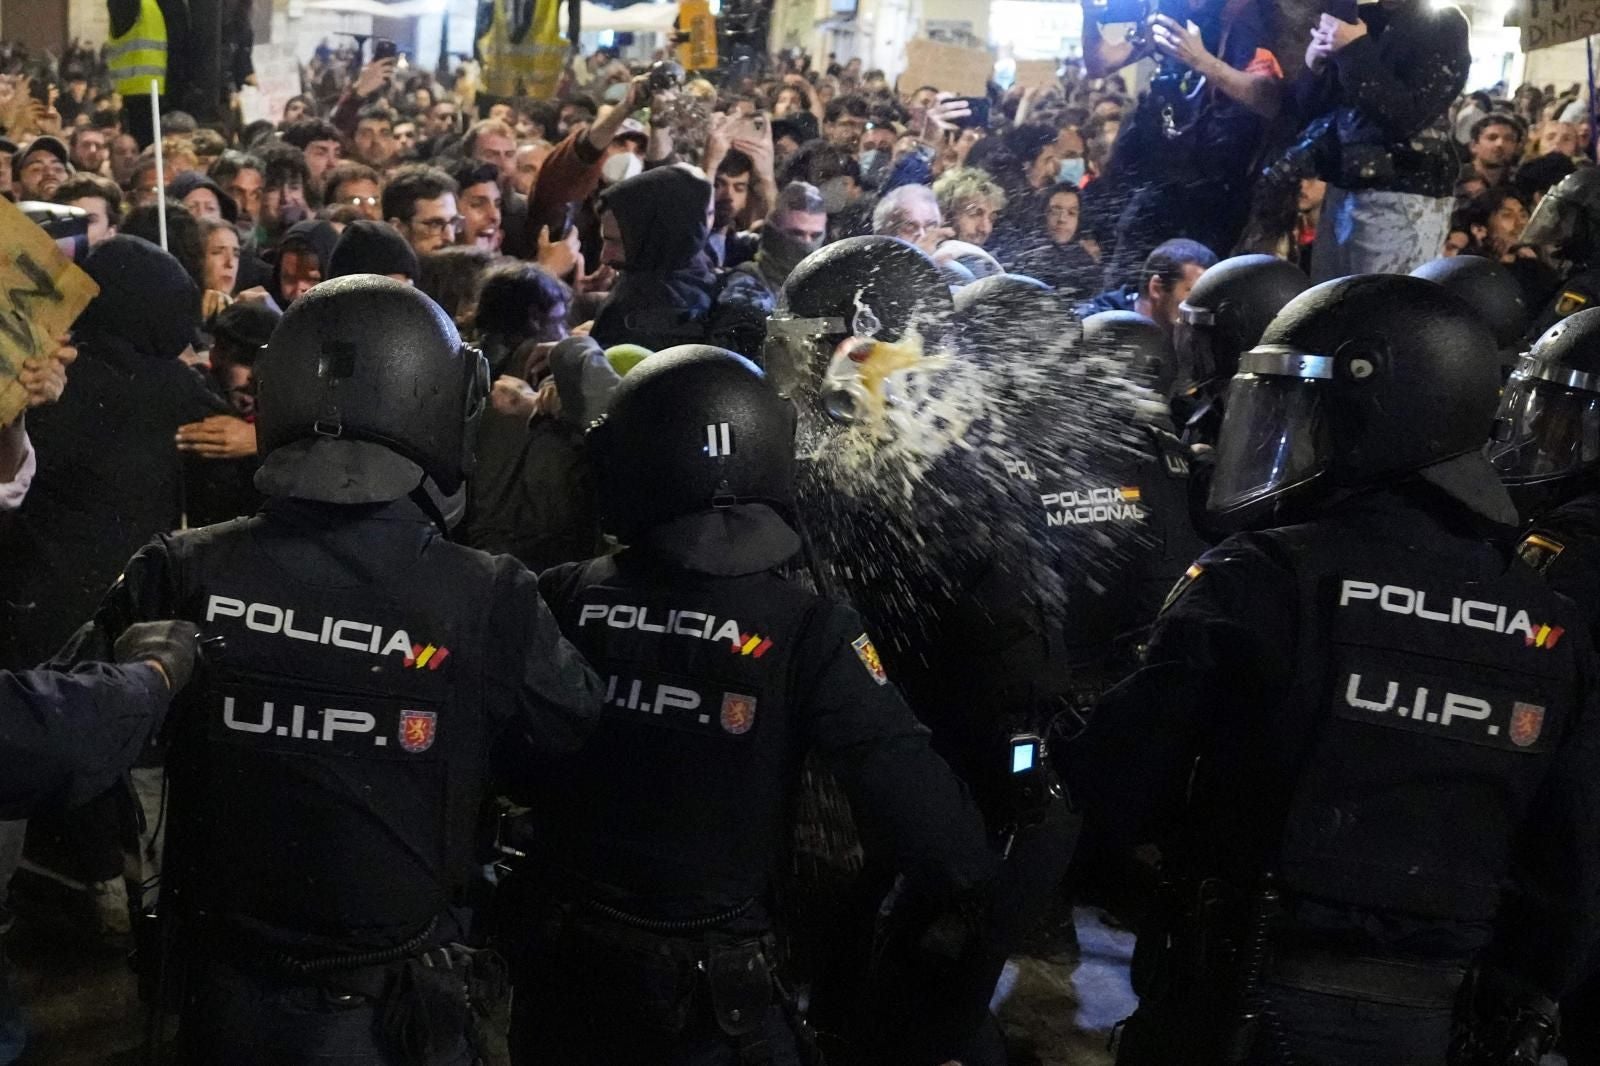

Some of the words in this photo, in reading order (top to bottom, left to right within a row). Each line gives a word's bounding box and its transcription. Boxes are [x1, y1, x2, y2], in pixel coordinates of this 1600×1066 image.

[1040, 487, 1126, 508] POLICIA
[1046, 504, 1145, 527] NACIONAL
[206, 594, 415, 660] POLICIA
[578, 604, 742, 647] POLICIA
[1339, 579, 1537, 640] POLICIA
[223, 696, 388, 746] U.I.P.
[1345, 673, 1500, 736] U.I.P.
